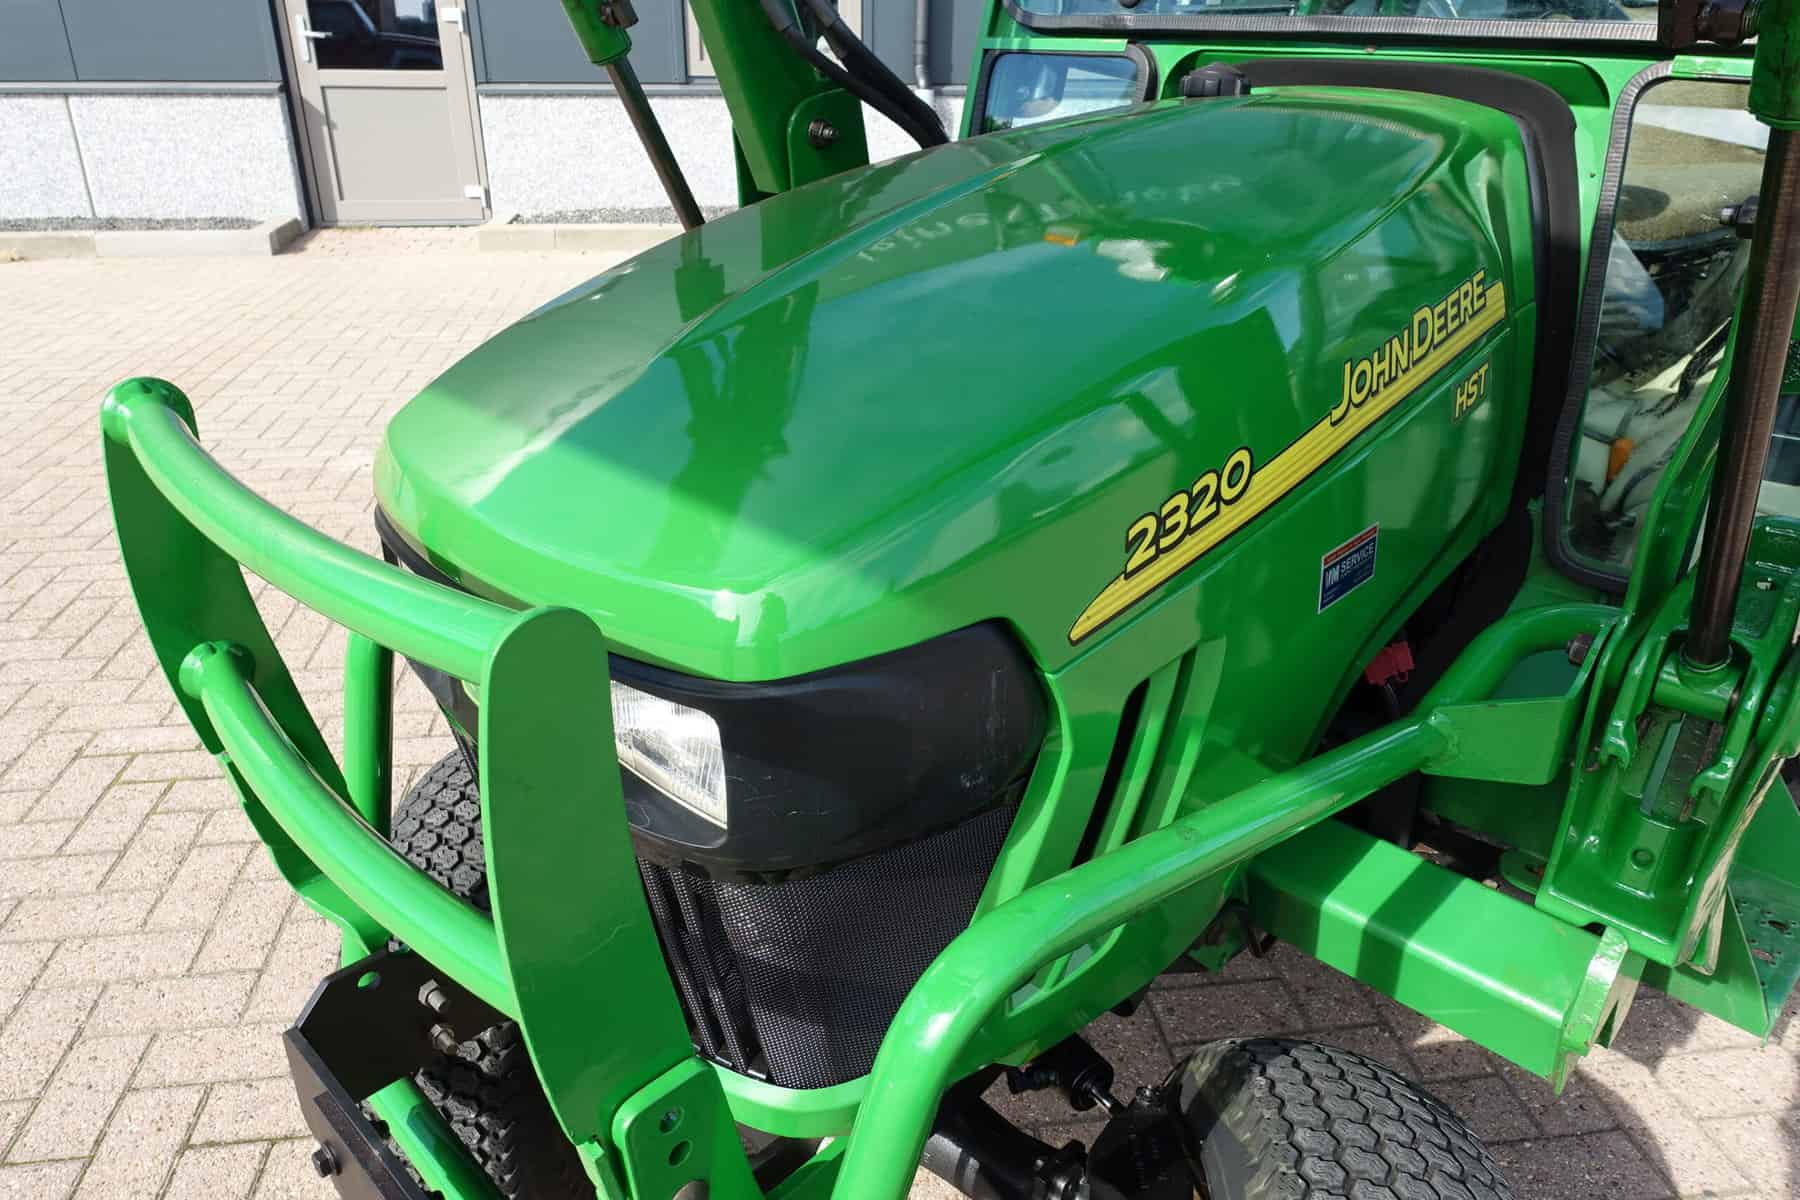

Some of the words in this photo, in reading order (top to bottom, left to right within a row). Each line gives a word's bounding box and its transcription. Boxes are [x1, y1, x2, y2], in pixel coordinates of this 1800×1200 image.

[1330, 327, 1411, 425] JOHN
[1411, 268, 1487, 364] DEERE
[1455, 362, 1488, 418] HST
[1124, 447, 1252, 580] 2320
[1341, 542, 1375, 572] SERVICE
